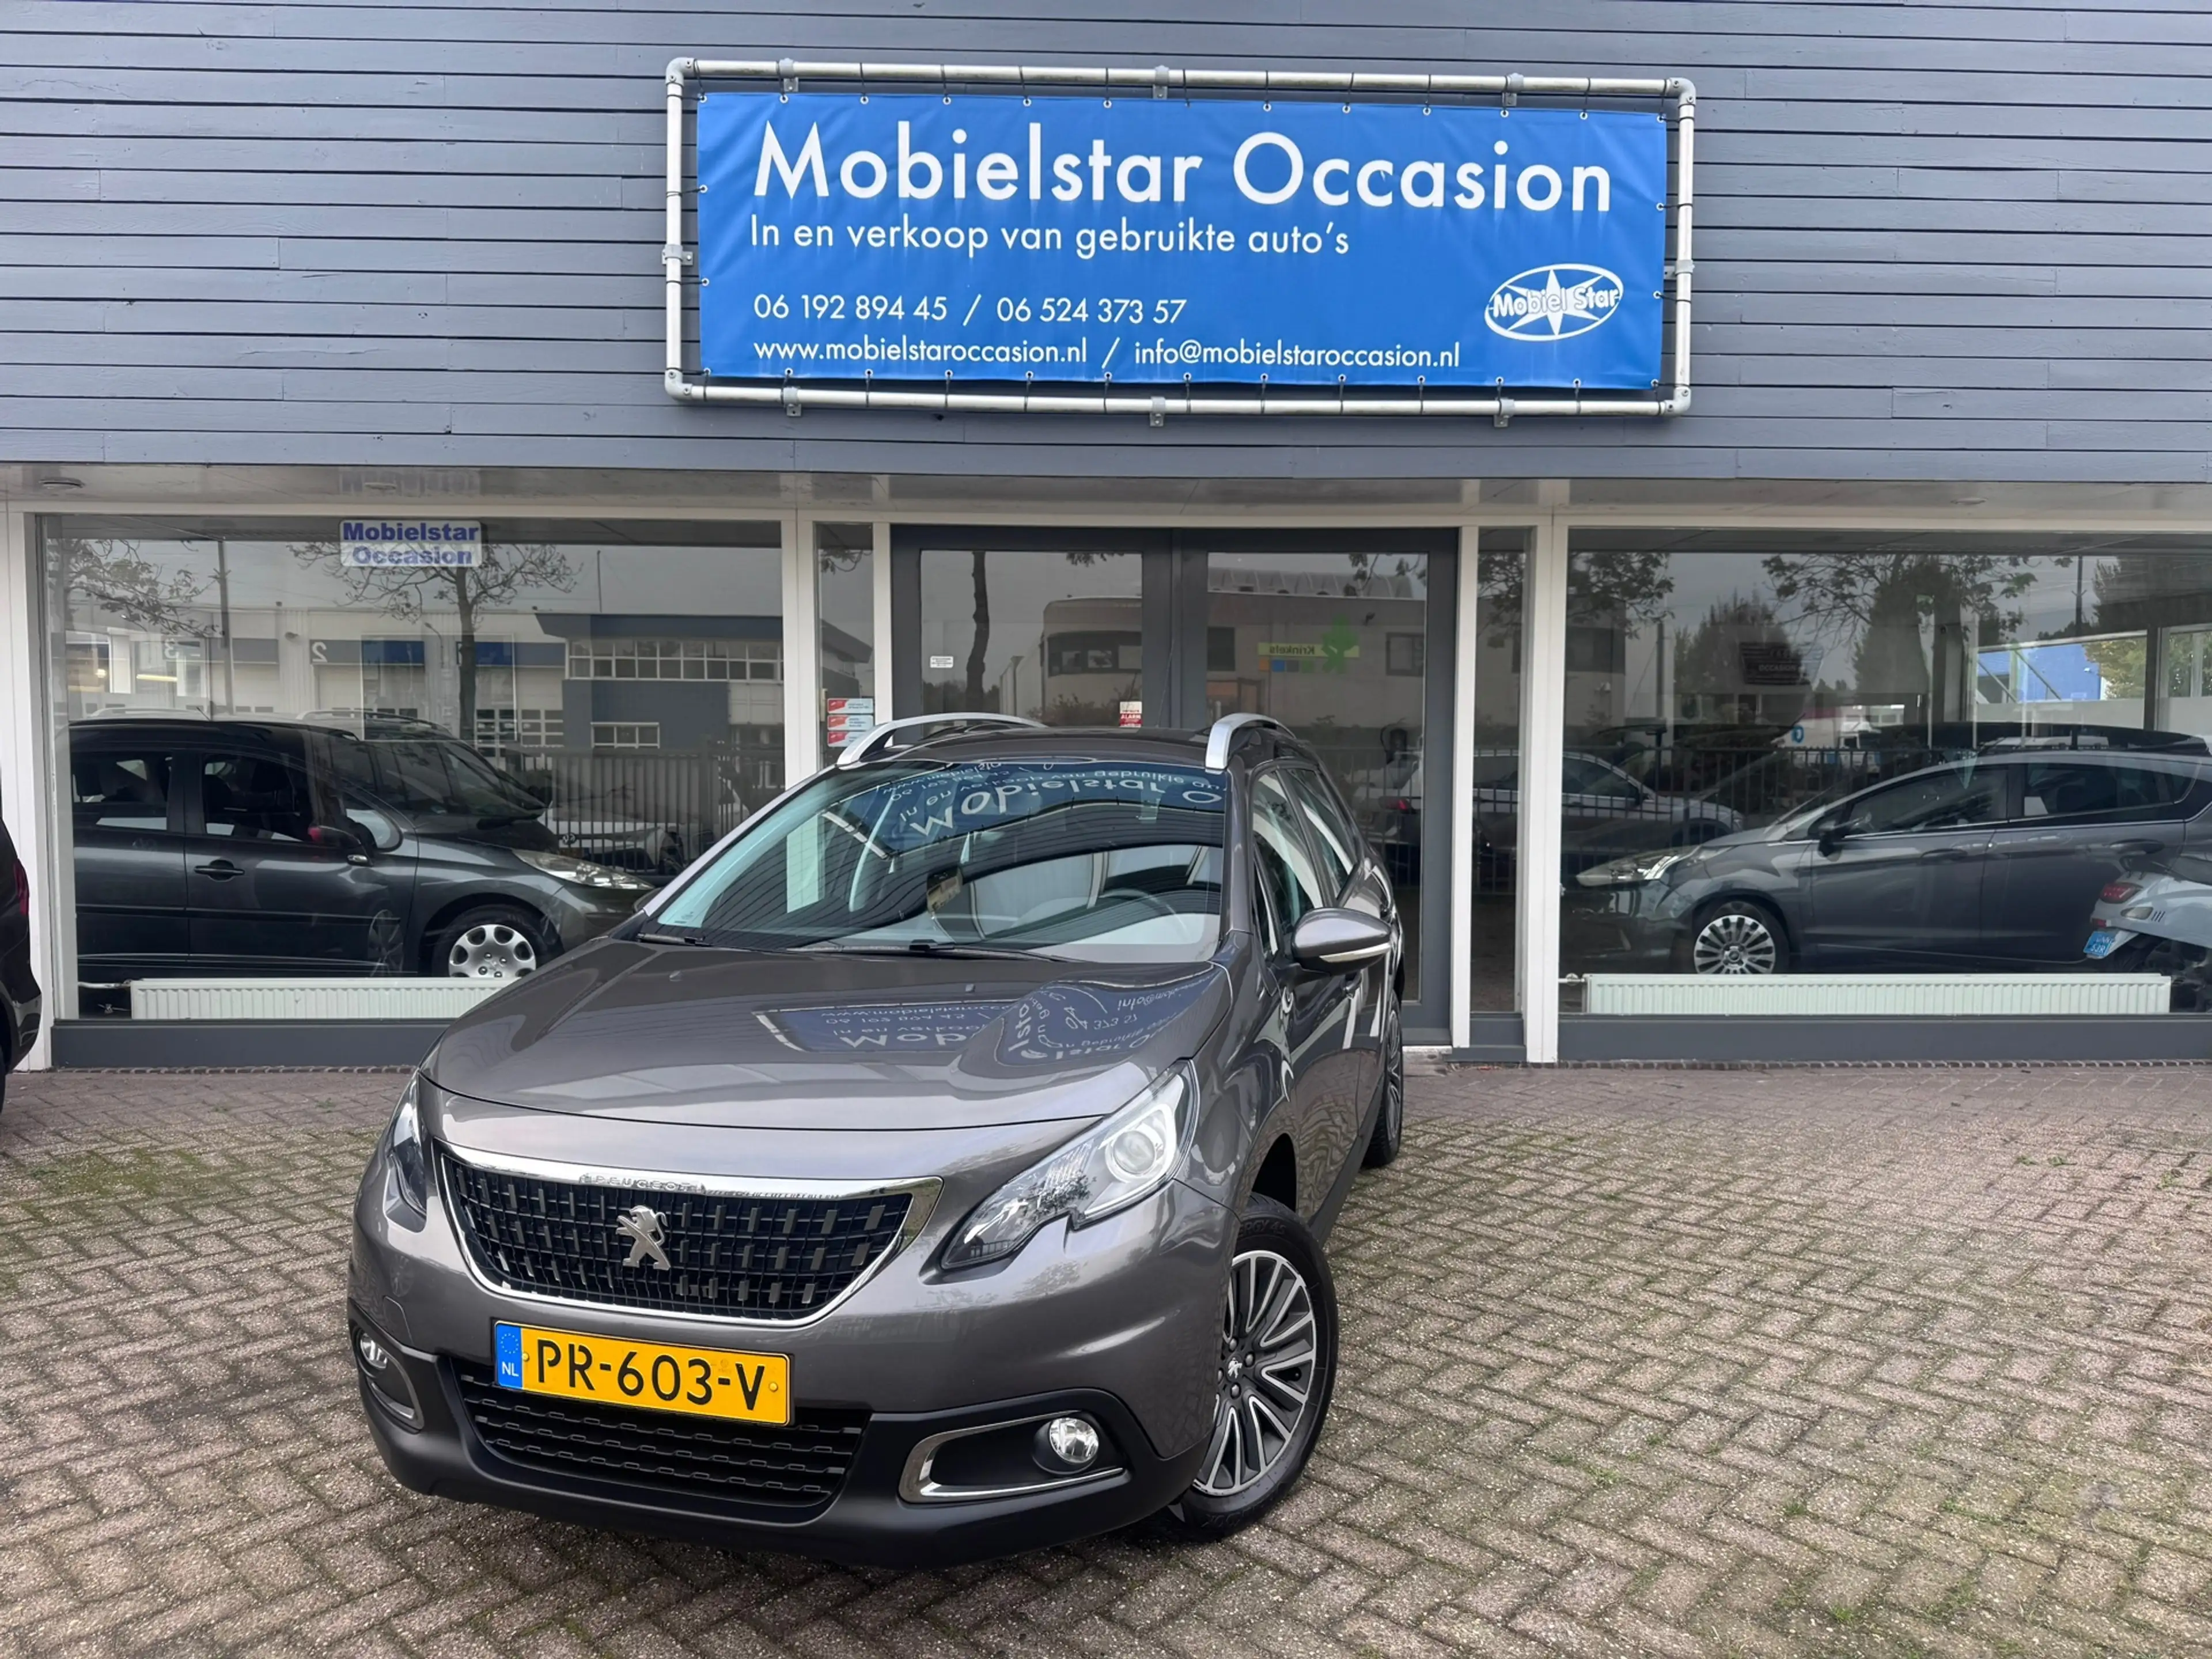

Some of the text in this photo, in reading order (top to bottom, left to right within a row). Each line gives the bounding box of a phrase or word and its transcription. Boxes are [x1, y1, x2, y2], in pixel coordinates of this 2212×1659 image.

[754, 121, 1610, 211] Mobielstar Occasion
[752, 213, 1349, 259] In en verkoop van gebruikte auto's
[754, 294, 789, 319] 06
[802, 295, 844, 319] 192
[856, 296, 904, 320] 894
[913, 297, 946, 320] 45
[997, 297, 1031, 322] 06
[1040, 298, 1088, 322] 524
[1098, 298, 1143, 324] 373
[1153, 300, 1187, 323] 57
[1493, 286, 1619, 317] Mobiel Star
[754, 335, 1086, 362] www.mobielstaroccasion.nl
[1136, 338, 1459, 366] info@mobielstaroccasion.nl
[343, 522, 480, 541] Mobielstar
[353, 546, 472, 565] Occasion
[501, 1361, 519, 1377] NL
[537, 1339, 765, 1411] PR-603-V
